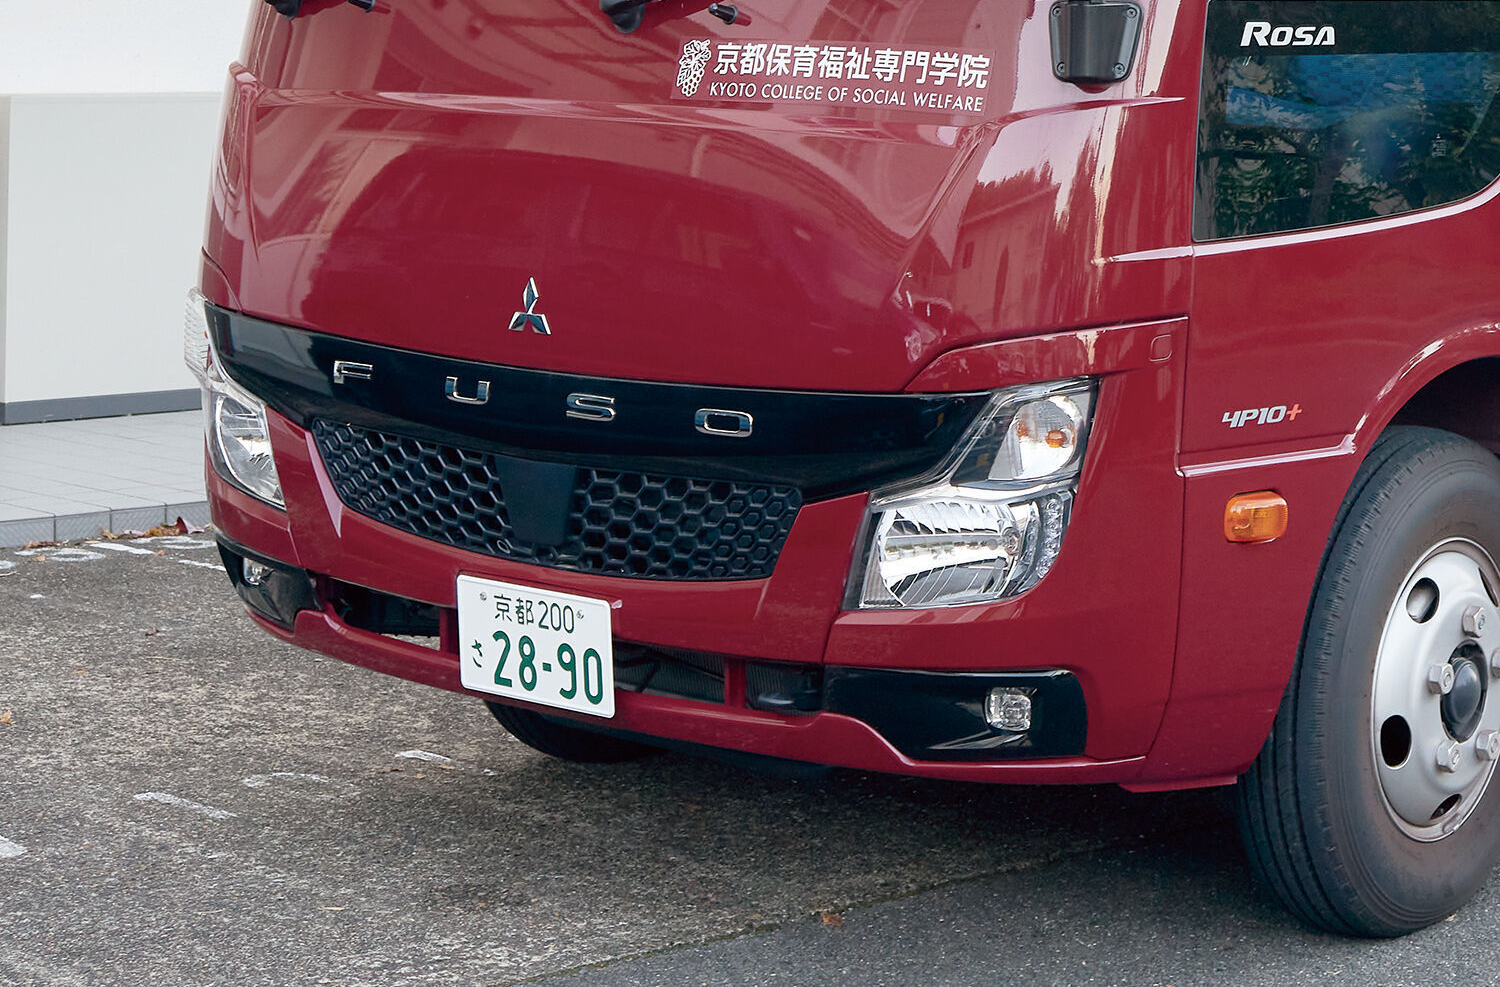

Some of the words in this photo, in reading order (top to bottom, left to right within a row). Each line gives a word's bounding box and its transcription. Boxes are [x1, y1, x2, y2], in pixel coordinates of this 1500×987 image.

[713, 42, 990, 89] 京都保育福祉専門学院
[709, 82, 757, 99] KYOTO
[762, 84, 823, 102] COLLEGE
[828, 87, 849, 103] OF
[852, 89, 906, 106] SOCIAL
[913, 91, 984, 113] WELFARE
[333, 358, 754, 438] FUSO
[471, 639, 483, 668] さ
[492, 630, 604, 705] 28-90
